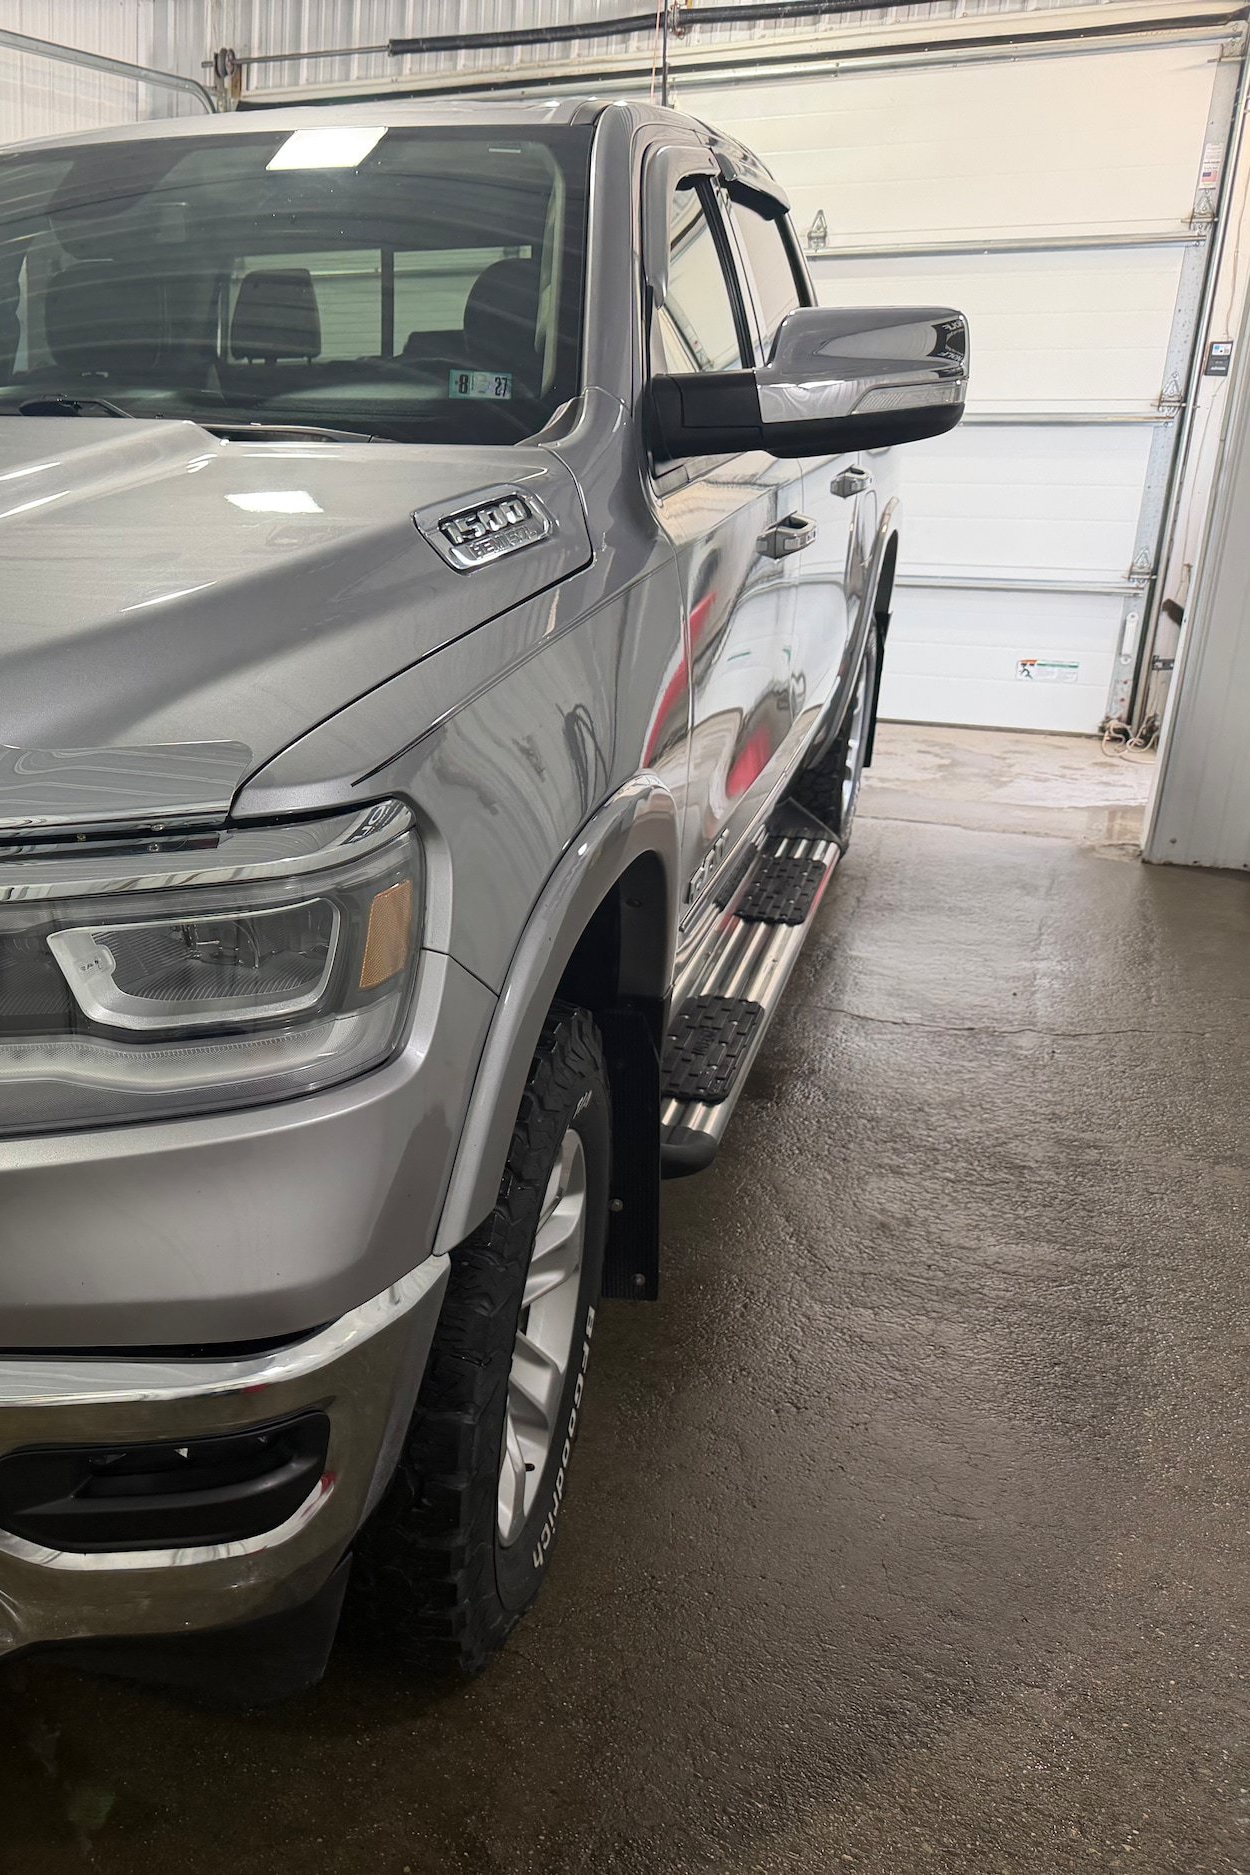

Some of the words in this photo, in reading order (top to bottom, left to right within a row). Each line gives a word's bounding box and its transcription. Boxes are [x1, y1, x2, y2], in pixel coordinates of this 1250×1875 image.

[458, 374, 469, 394] 8
[494, 376, 508, 398] 27
[441, 499, 526, 545] 1500
[532, 1305, 596, 1569] BFGoodrich
